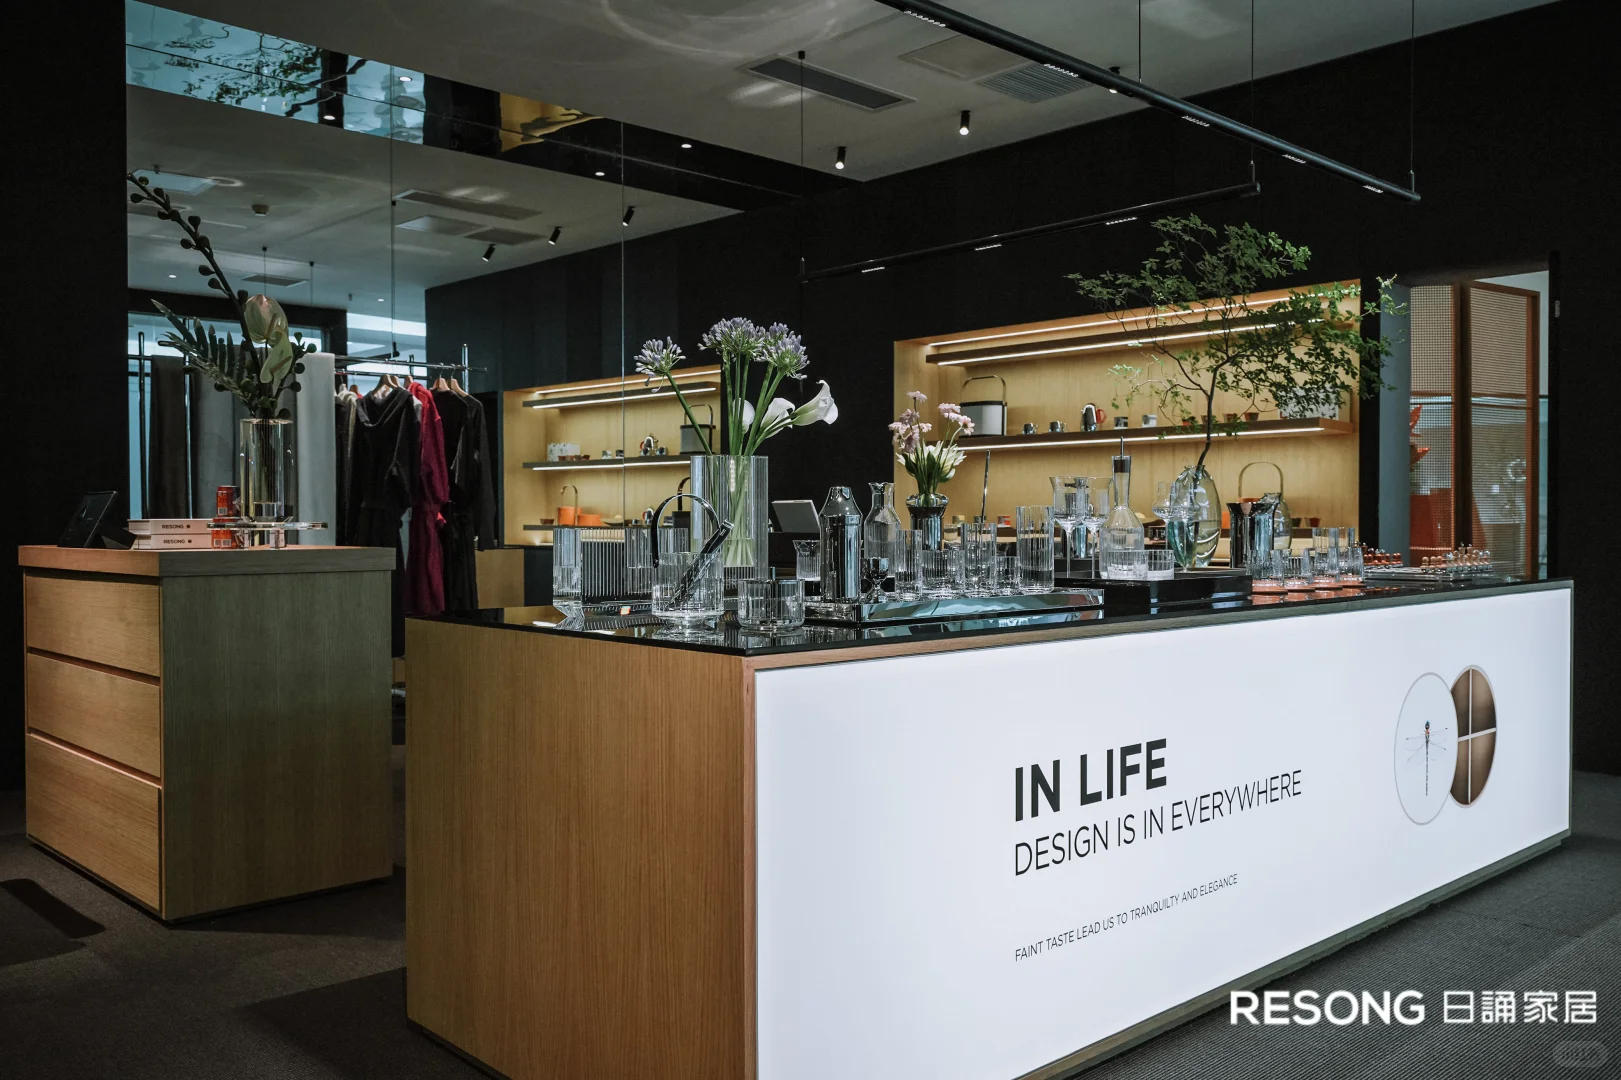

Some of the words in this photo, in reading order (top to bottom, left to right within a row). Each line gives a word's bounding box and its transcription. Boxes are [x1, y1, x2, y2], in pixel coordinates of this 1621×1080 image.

[1015, 759, 1060, 822] IN
[1080, 738, 1167, 806] LIFE
[1015, 820, 1109, 876] DESIGN
[1117, 814, 1136, 847] IS
[1143, 806, 1164, 840] IN
[1171, 769, 1302, 831] EVERYWHERE
[1015, 940, 1044, 962] FAINT
[1046, 930, 1075, 951] TASTE
[1076, 922, 1101, 940] LEAD
[1102, 916, 1115, 931] US
[1116, 912, 1128, 926] TO
[1181, 887, 1199, 903] AND
[1199, 873, 1238, 897] ELEGANCE
